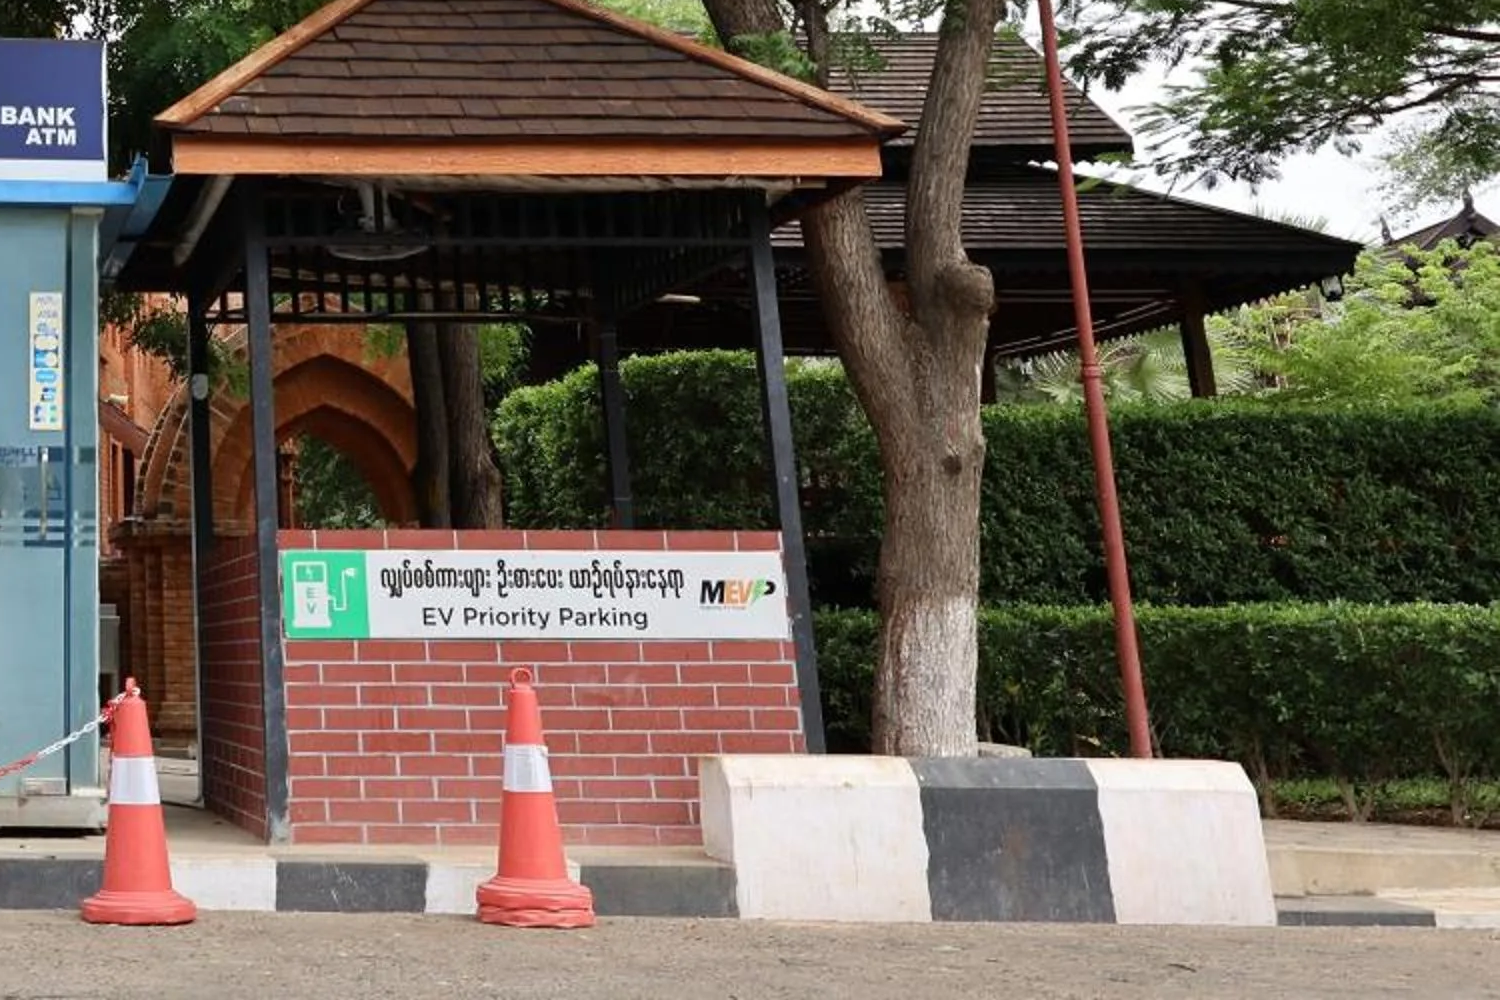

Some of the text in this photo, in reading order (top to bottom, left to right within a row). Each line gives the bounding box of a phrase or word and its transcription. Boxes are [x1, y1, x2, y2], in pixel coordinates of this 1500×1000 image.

[0, 105, 76, 127] BANK
[25, 127, 77, 146] ATM
[422, 607, 648, 631] EV Priority Parking
